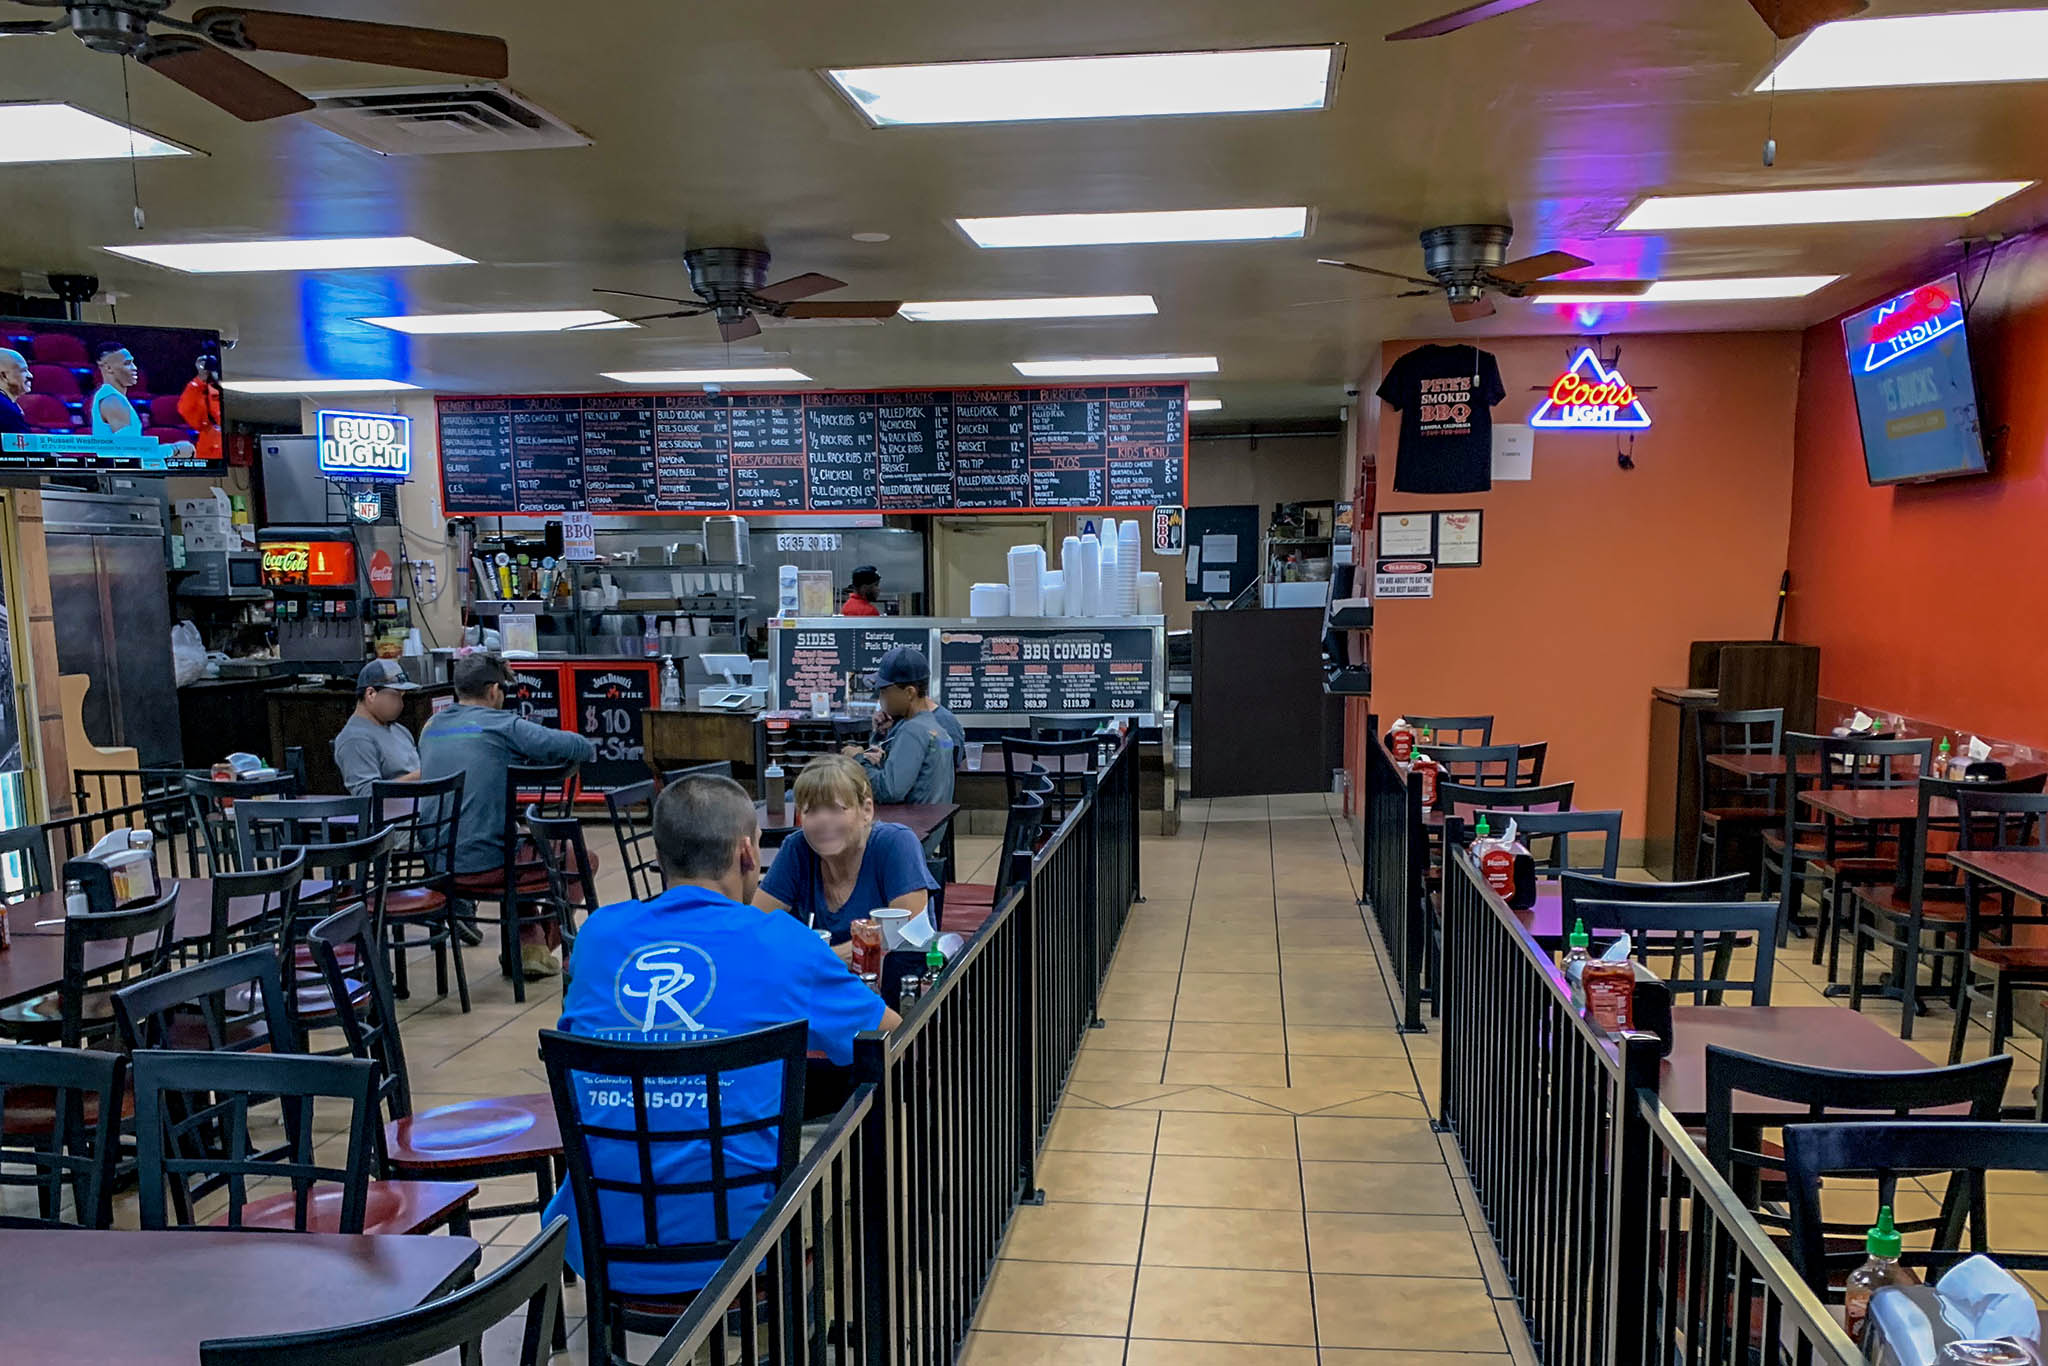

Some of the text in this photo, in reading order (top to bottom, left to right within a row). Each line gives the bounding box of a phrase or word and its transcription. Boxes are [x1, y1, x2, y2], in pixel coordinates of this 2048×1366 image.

[1420, 377, 1471, 393] PETE'S
[1553, 373, 1638, 405] Coors
[1040, 389, 1088, 401] BURRITOS
[1129, 387, 1159, 398] FRIES
[1421, 392, 1471, 404] SMOKED
[1110, 401, 1129, 409] PULLED
[657, 411, 674, 420] BUILD
[675, 411, 690, 420] YOUR
[880, 407, 926, 418] PULLED PORK
[957, 406, 999, 418] PULLED PORK
[1420, 403, 1472, 423] BBQ
[1562, 405, 1620, 422] LIGHT
[821, 414, 838, 426] RACK
[839, 414, 856, 426] RIBS
[887, 420, 917, 430] CHICKEN
[333, 417, 396, 444] BUD
[957, 423, 989, 434] CHICKEN
[1120, 424, 1131, 432] TIP
[820, 434, 838, 446] RACK
[838, 434, 854, 446] RIBS
[888, 432, 924, 443] RACK RIBS
[888, 444, 924, 454] RACK RIBS
[957, 441, 987, 452] BRISKET
[1118, 447, 1170, 458] KIDS MENU
[324, 439, 407, 468] LIGHT
[809, 452, 863, 464] FULL RACK RIBS
[880, 455, 905, 463] TRI TIP
[881, 463, 910, 473] BRISKET
[957, 459, 985, 469] TRI TIP
[1049, 456, 1080, 469] TACOS
[1110, 460, 1133, 468] GRILLED
[737, 469, 759, 478] FRIES
[820, 469, 853, 481] CHICKEN
[957, 475, 981, 486] PULLED
[981, 475, 997, 486] PORK
[997, 474, 1020, 485] SLIDERS
[737, 487, 781, 498] ONION RINGS
[811, 485, 863, 498] FULL CHICKEN
[880, 485, 899, 495] PULLED
[931, 484, 952, 494] CHEESE
[361, 504, 378, 518] NFL
[564, 523, 593, 541] BBQ
[1157, 515, 1169, 548] BBQ
[263, 550, 309, 572] Coca-Cola
[797, 632, 836, 645] SIDES
[865, 632, 895, 641] Catering
[865, 642, 881, 650] Pick
[882, 642, 892, 651] Up
[1023, 643, 1112, 661] BBQ COMBO'S
[657, 1077, 679, 1087] Heart
